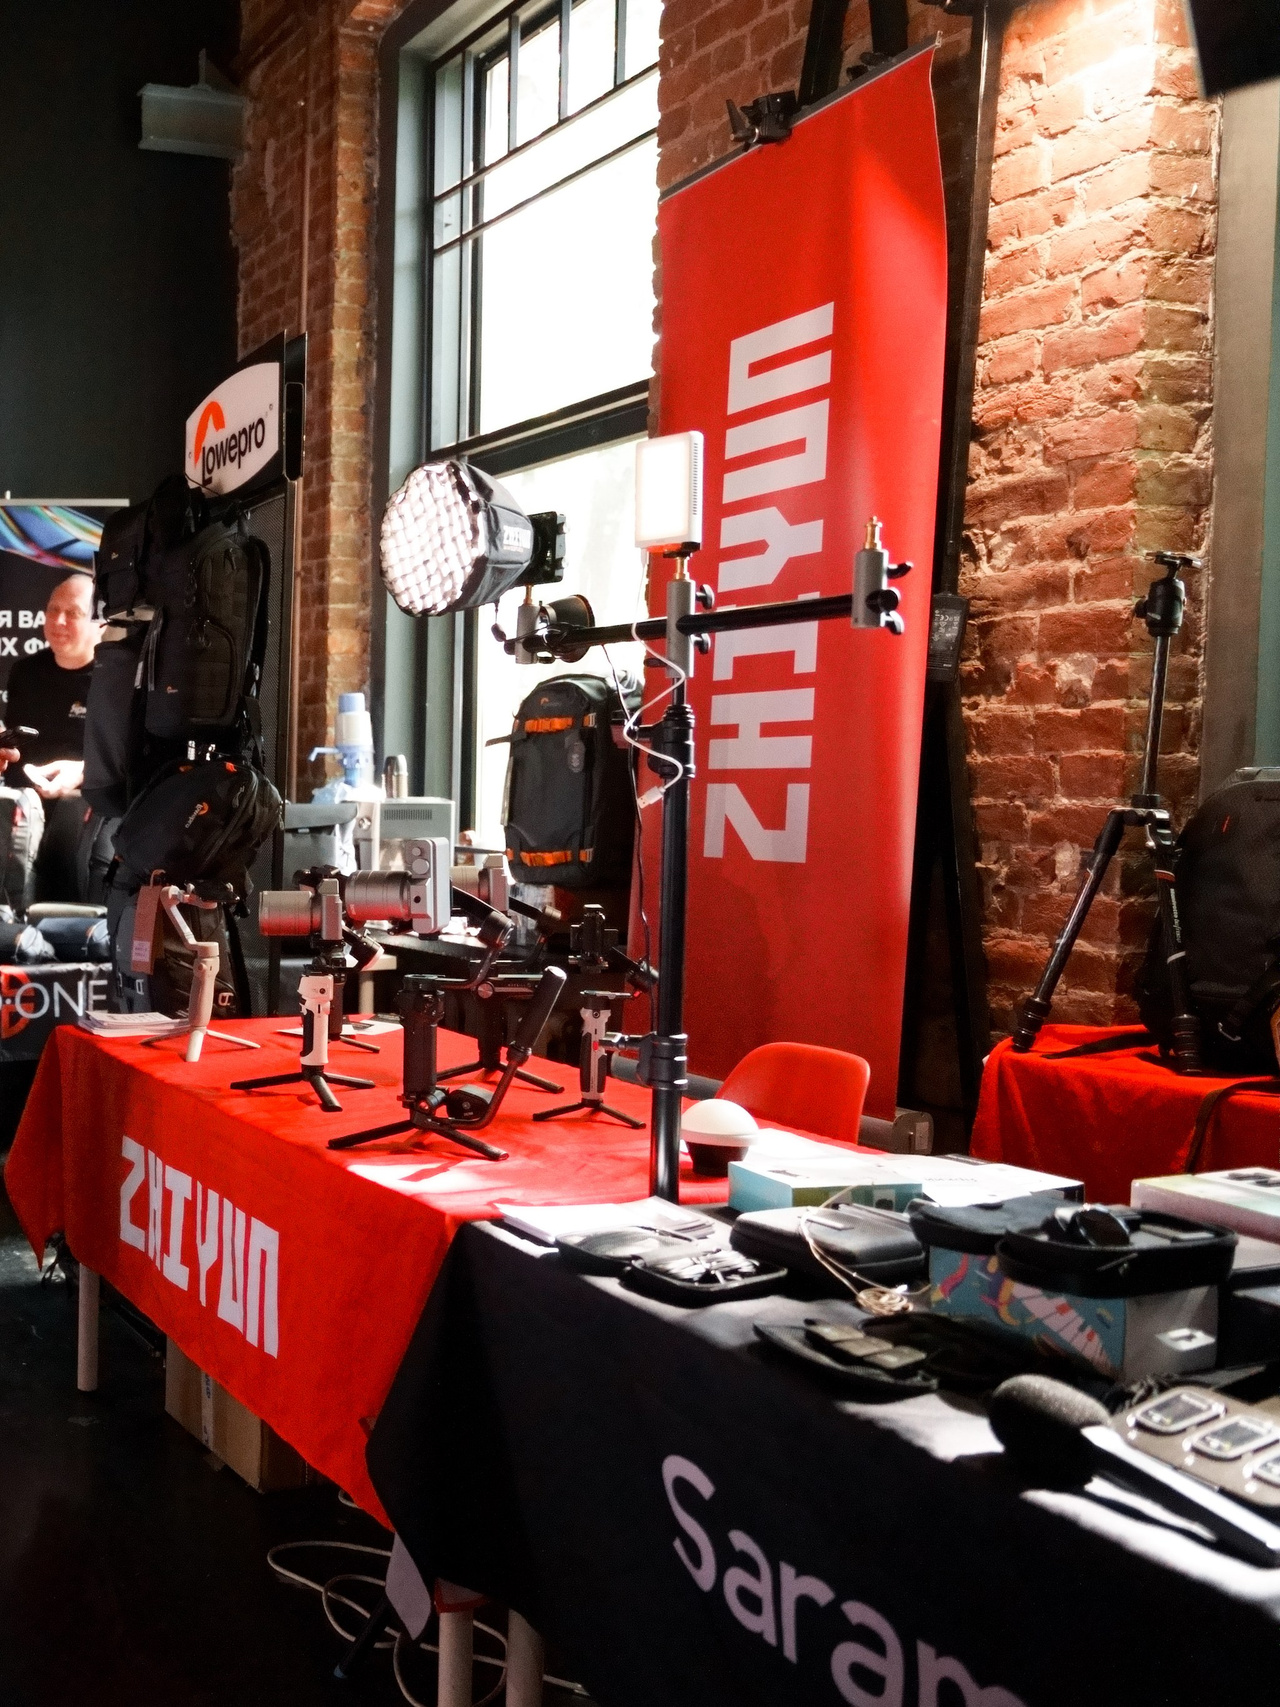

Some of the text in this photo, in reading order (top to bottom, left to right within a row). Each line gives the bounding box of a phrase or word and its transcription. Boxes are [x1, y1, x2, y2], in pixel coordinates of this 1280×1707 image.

[202, 418, 265, 486] Lowepro
[18, 610, 46, 628] ВА
[703, 301, 834, 863] ZHIYUN
[120, 1135, 280, 1359] ZHIYUN
[661, 1455, 1028, 1707] Saram
